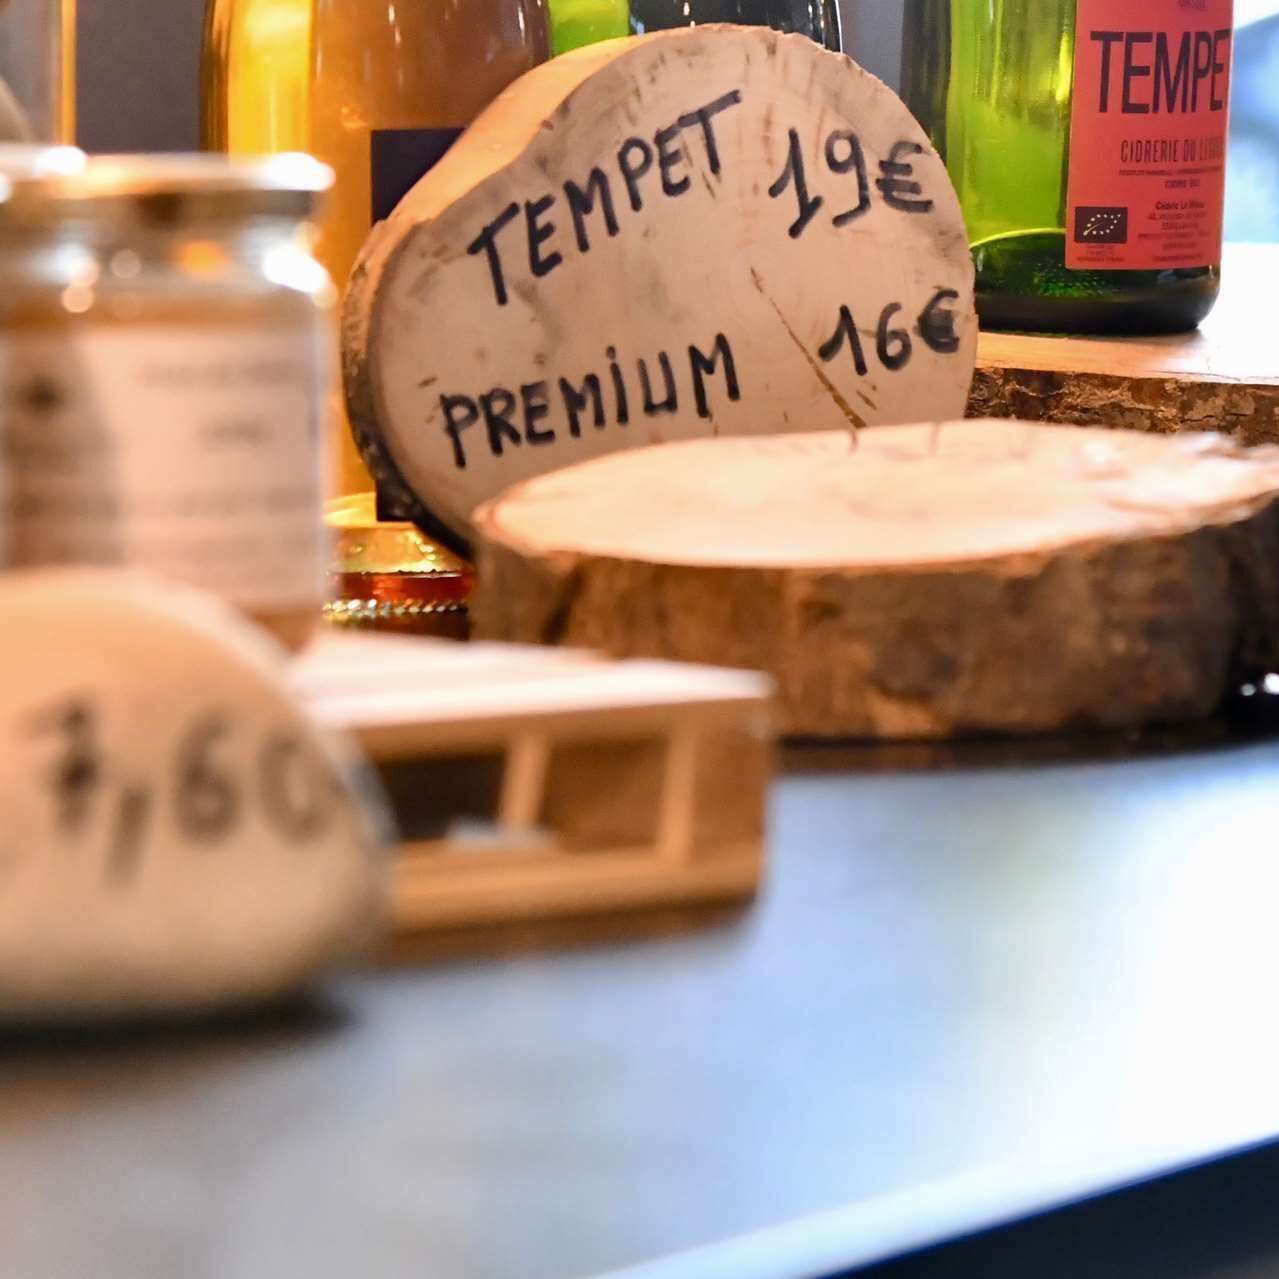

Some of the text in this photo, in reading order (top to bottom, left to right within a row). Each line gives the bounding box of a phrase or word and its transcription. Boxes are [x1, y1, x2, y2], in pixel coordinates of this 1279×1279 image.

[1090, 29, 1231, 114] TEMPE
[467, 89, 933, 306] TEMPET 19€
[1120, 138, 1178, 163] CIDRERIE
[438, 289, 960, 468] PREMIUM 16€
